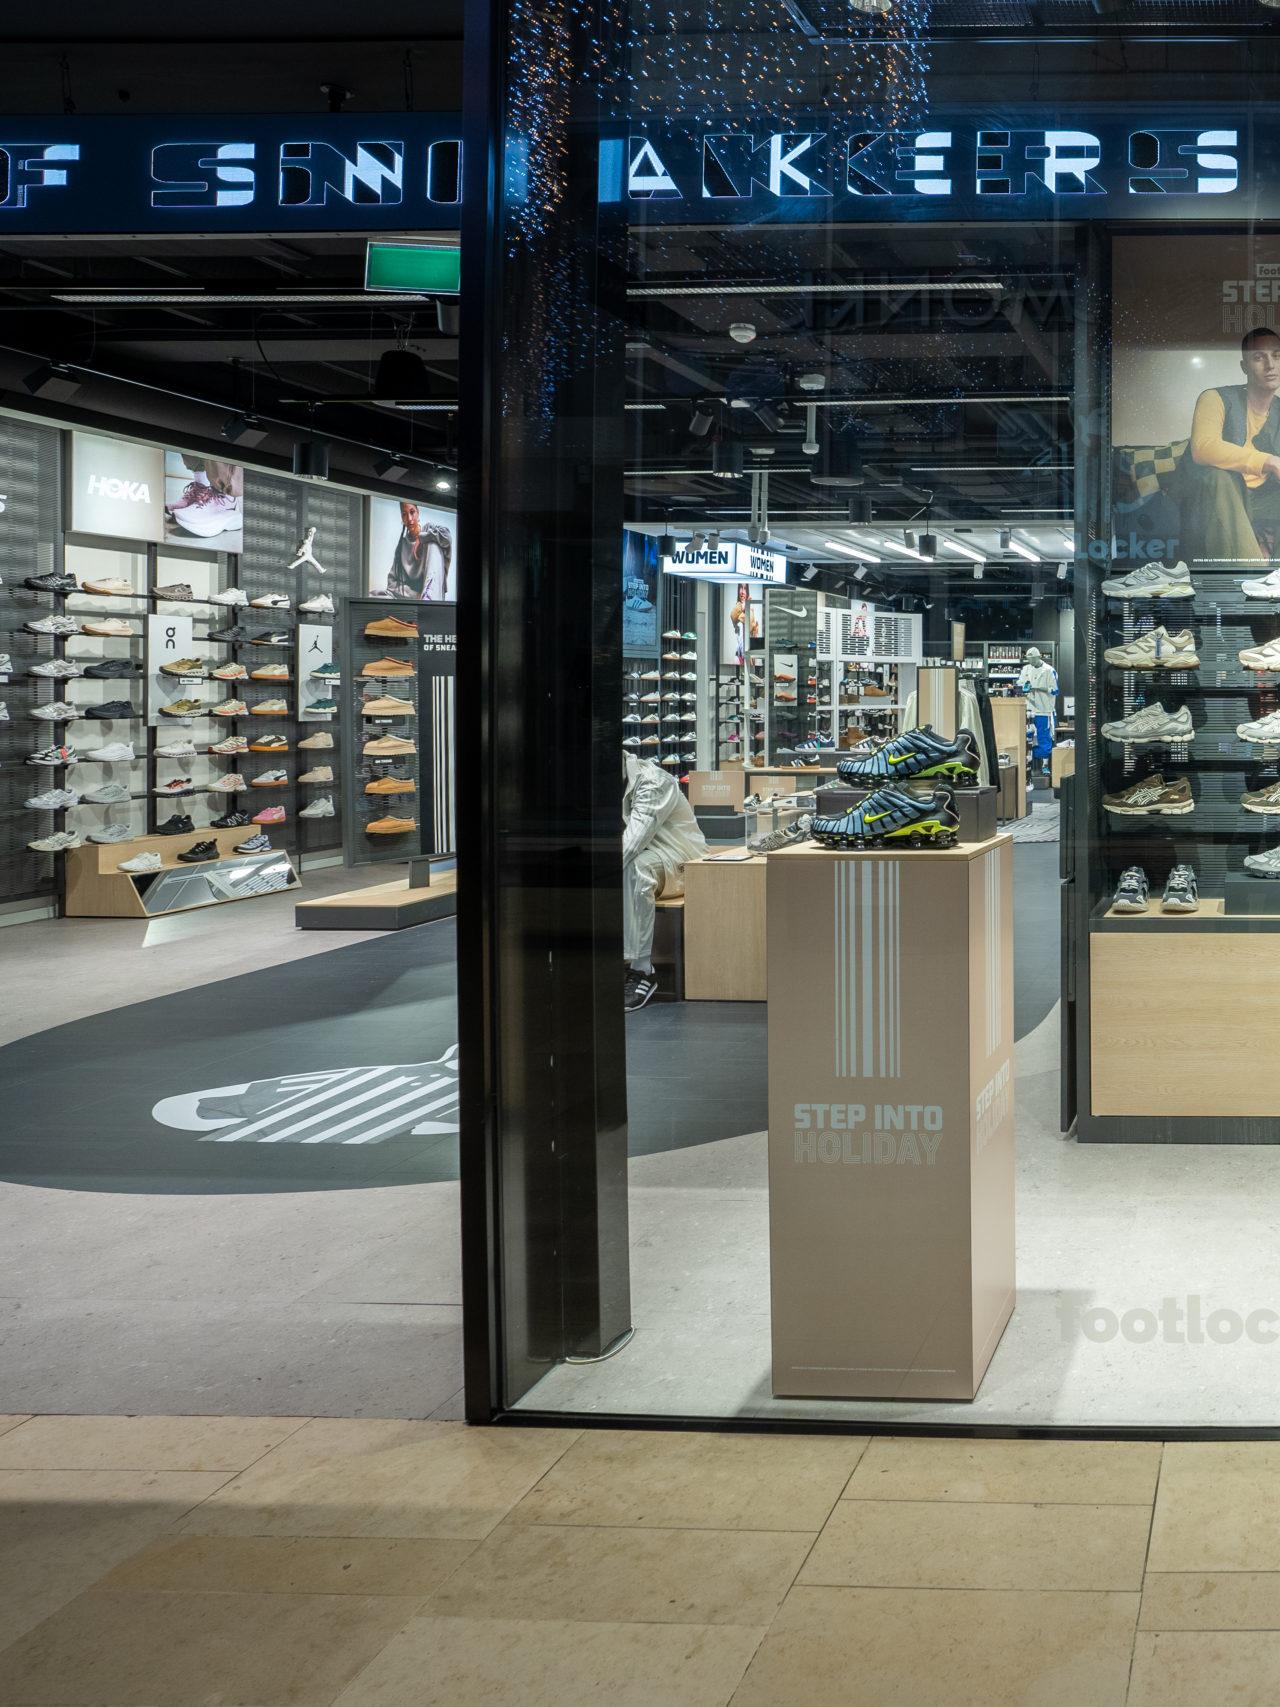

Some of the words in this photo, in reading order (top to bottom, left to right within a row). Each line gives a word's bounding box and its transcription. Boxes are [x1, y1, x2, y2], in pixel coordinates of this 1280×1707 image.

[87, 474, 151, 504] HOKA
[671, 550, 729, 565] WOMEN
[751, 555, 774, 574] WOMEN
[423, 634, 443, 643] THE
[976, 1078, 993, 1121] STEP
[794, 1103, 866, 1129] STEP
[874, 1104, 943, 1131] INTO
[794, 1131, 944, 1166] HOLIDAY
